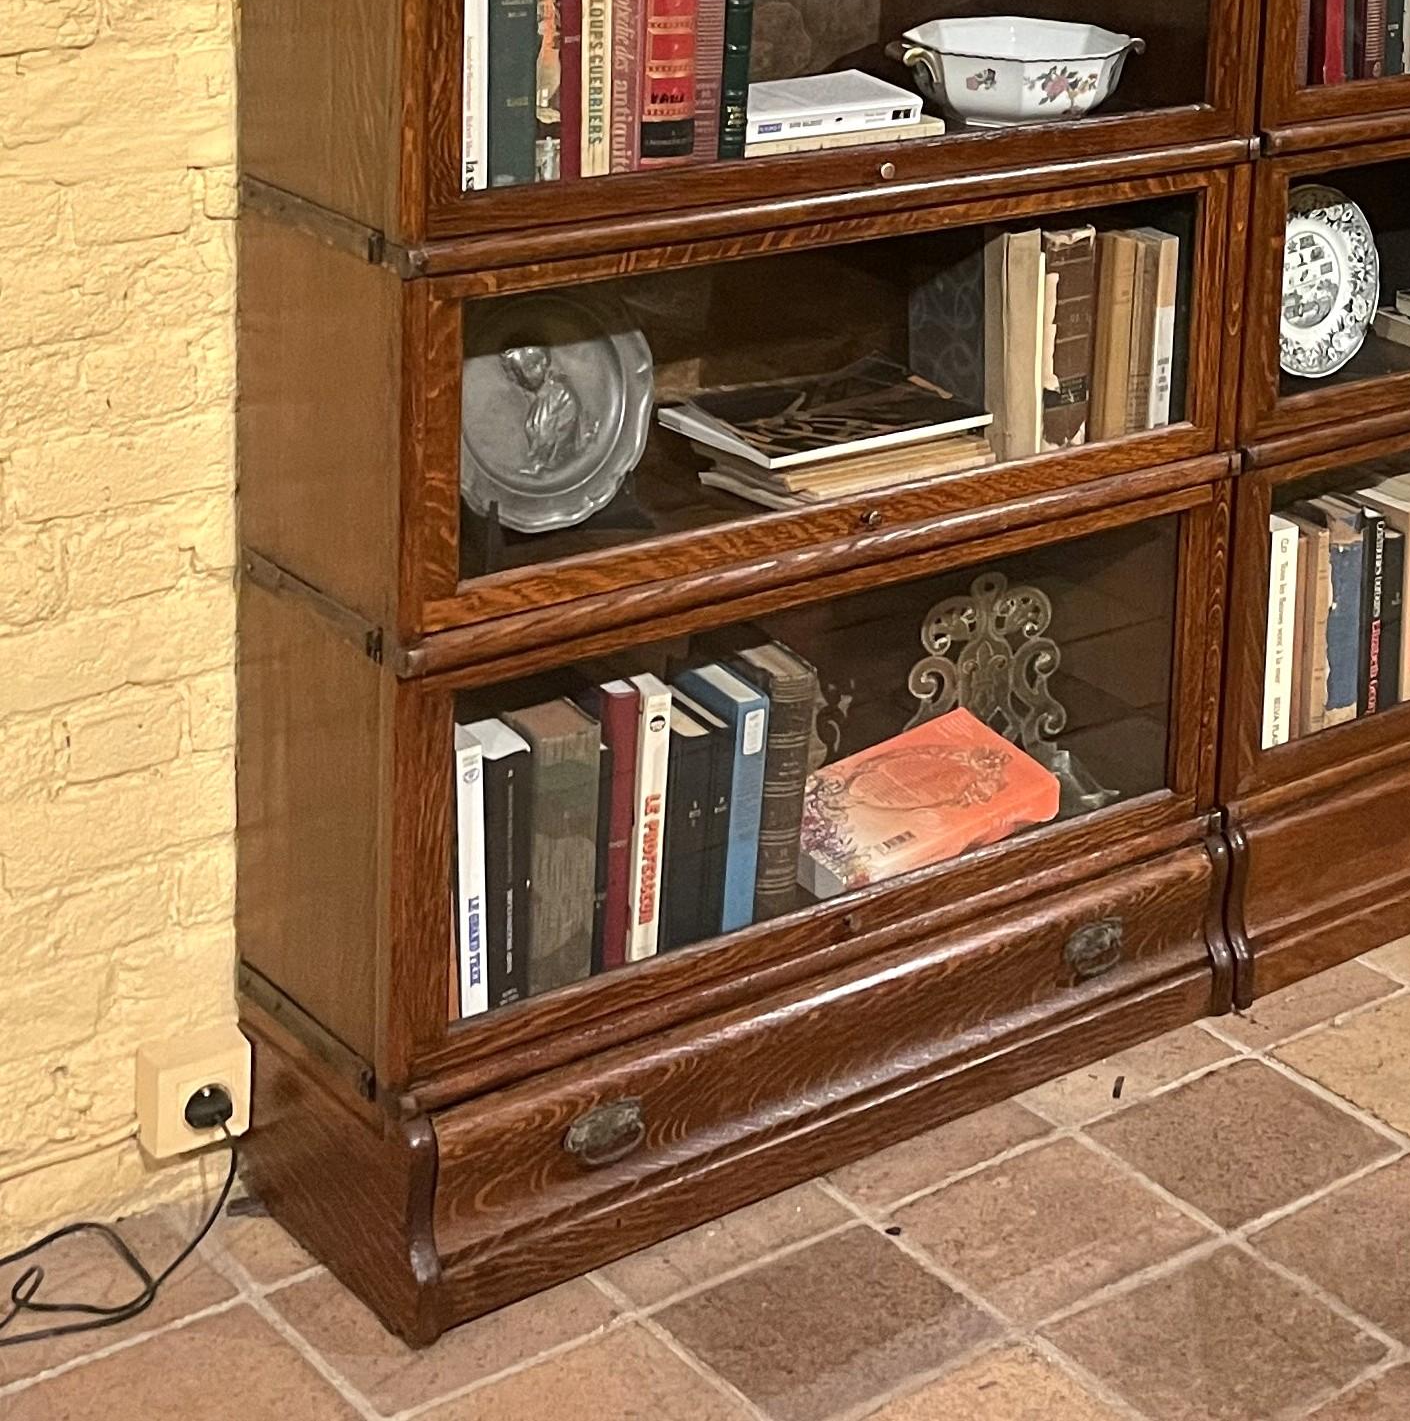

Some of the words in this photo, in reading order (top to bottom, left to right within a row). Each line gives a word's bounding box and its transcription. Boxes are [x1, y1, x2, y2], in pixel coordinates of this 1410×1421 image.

[588, 54, 604, 145] GUERRIERS
[465, 160, 479, 174] la
[1280, 561, 1289, 581] Tous
[1279, 583, 1288, 594] les
[1275, 656, 1284, 665] la
[645, 793, 661, 817] LE
[638, 819, 660, 926] PROFESSEUR
[468, 895, 480, 913] LE
